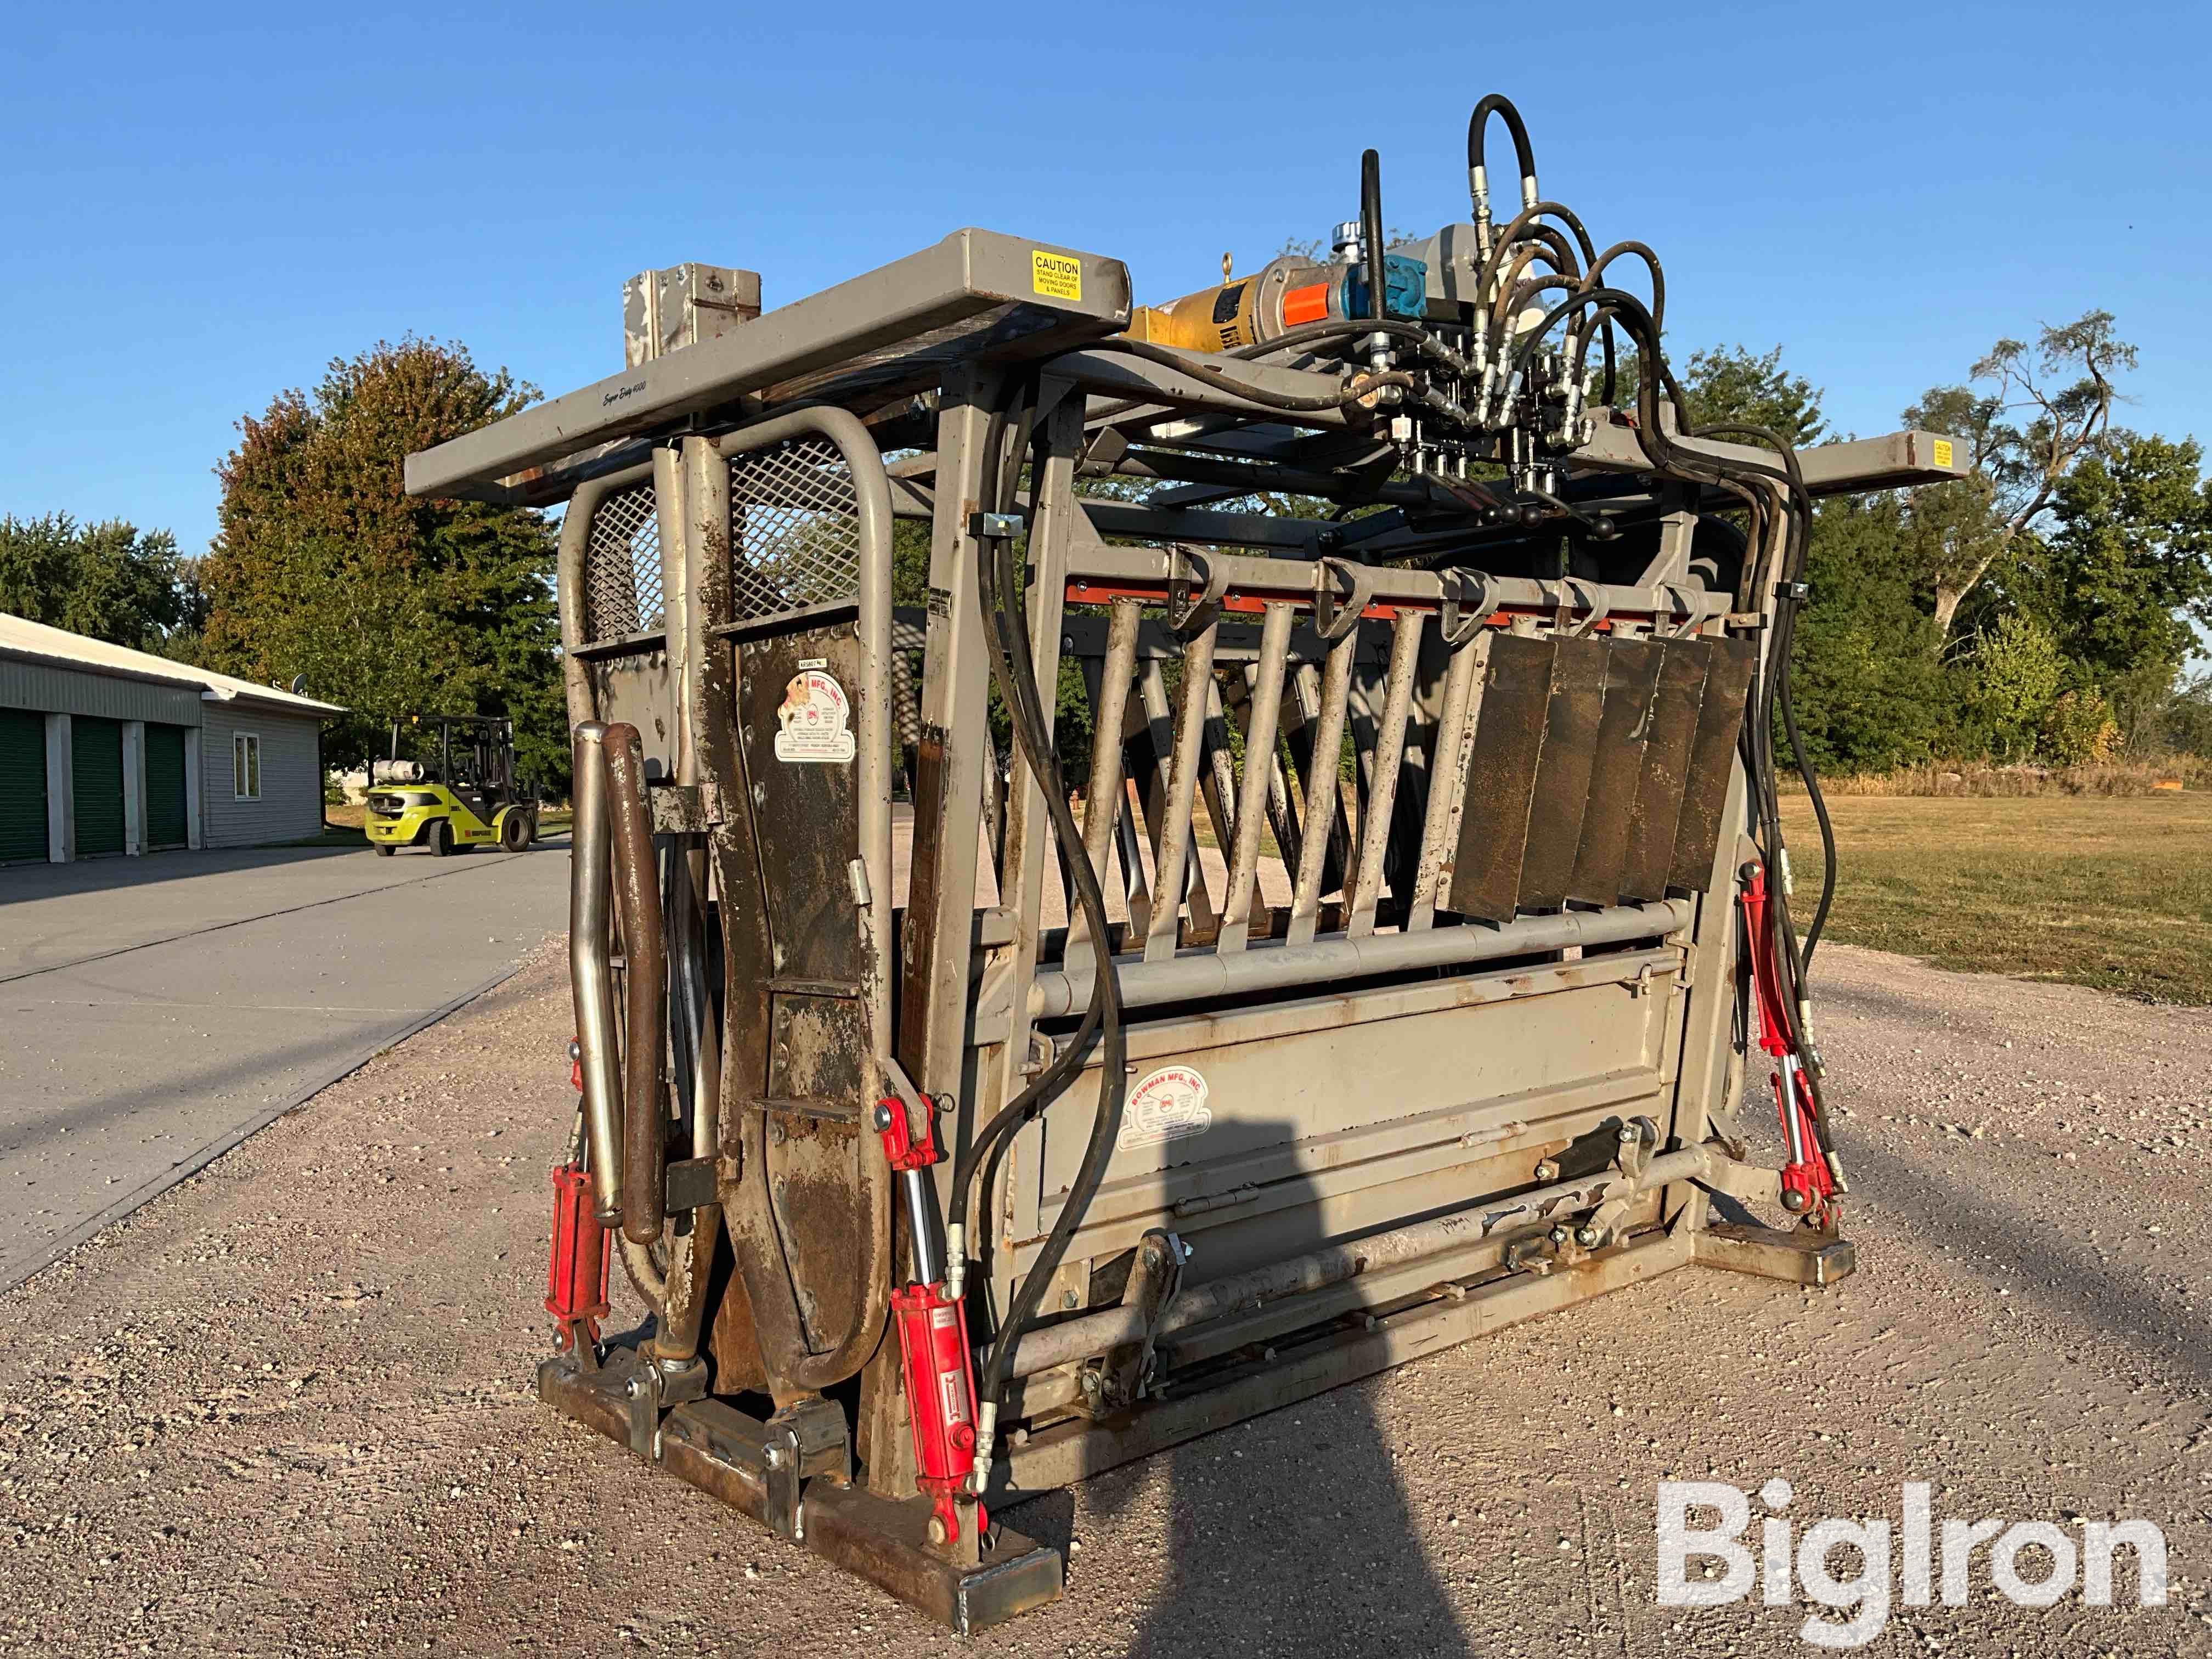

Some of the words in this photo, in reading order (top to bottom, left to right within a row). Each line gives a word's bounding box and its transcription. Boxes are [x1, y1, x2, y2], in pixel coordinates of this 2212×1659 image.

[1036, 257, 1078, 275] CAUTION
[1039, 276, 1058, 286] MOVING
[1059, 281, 1076, 290] DOORS
[1051, 287, 1070, 296] PANELS
[831, 688, 842, 709] INC.
[1132, 1075, 1165, 1105] BOWMAN
[1188, 1077, 1200, 1093] INC.
